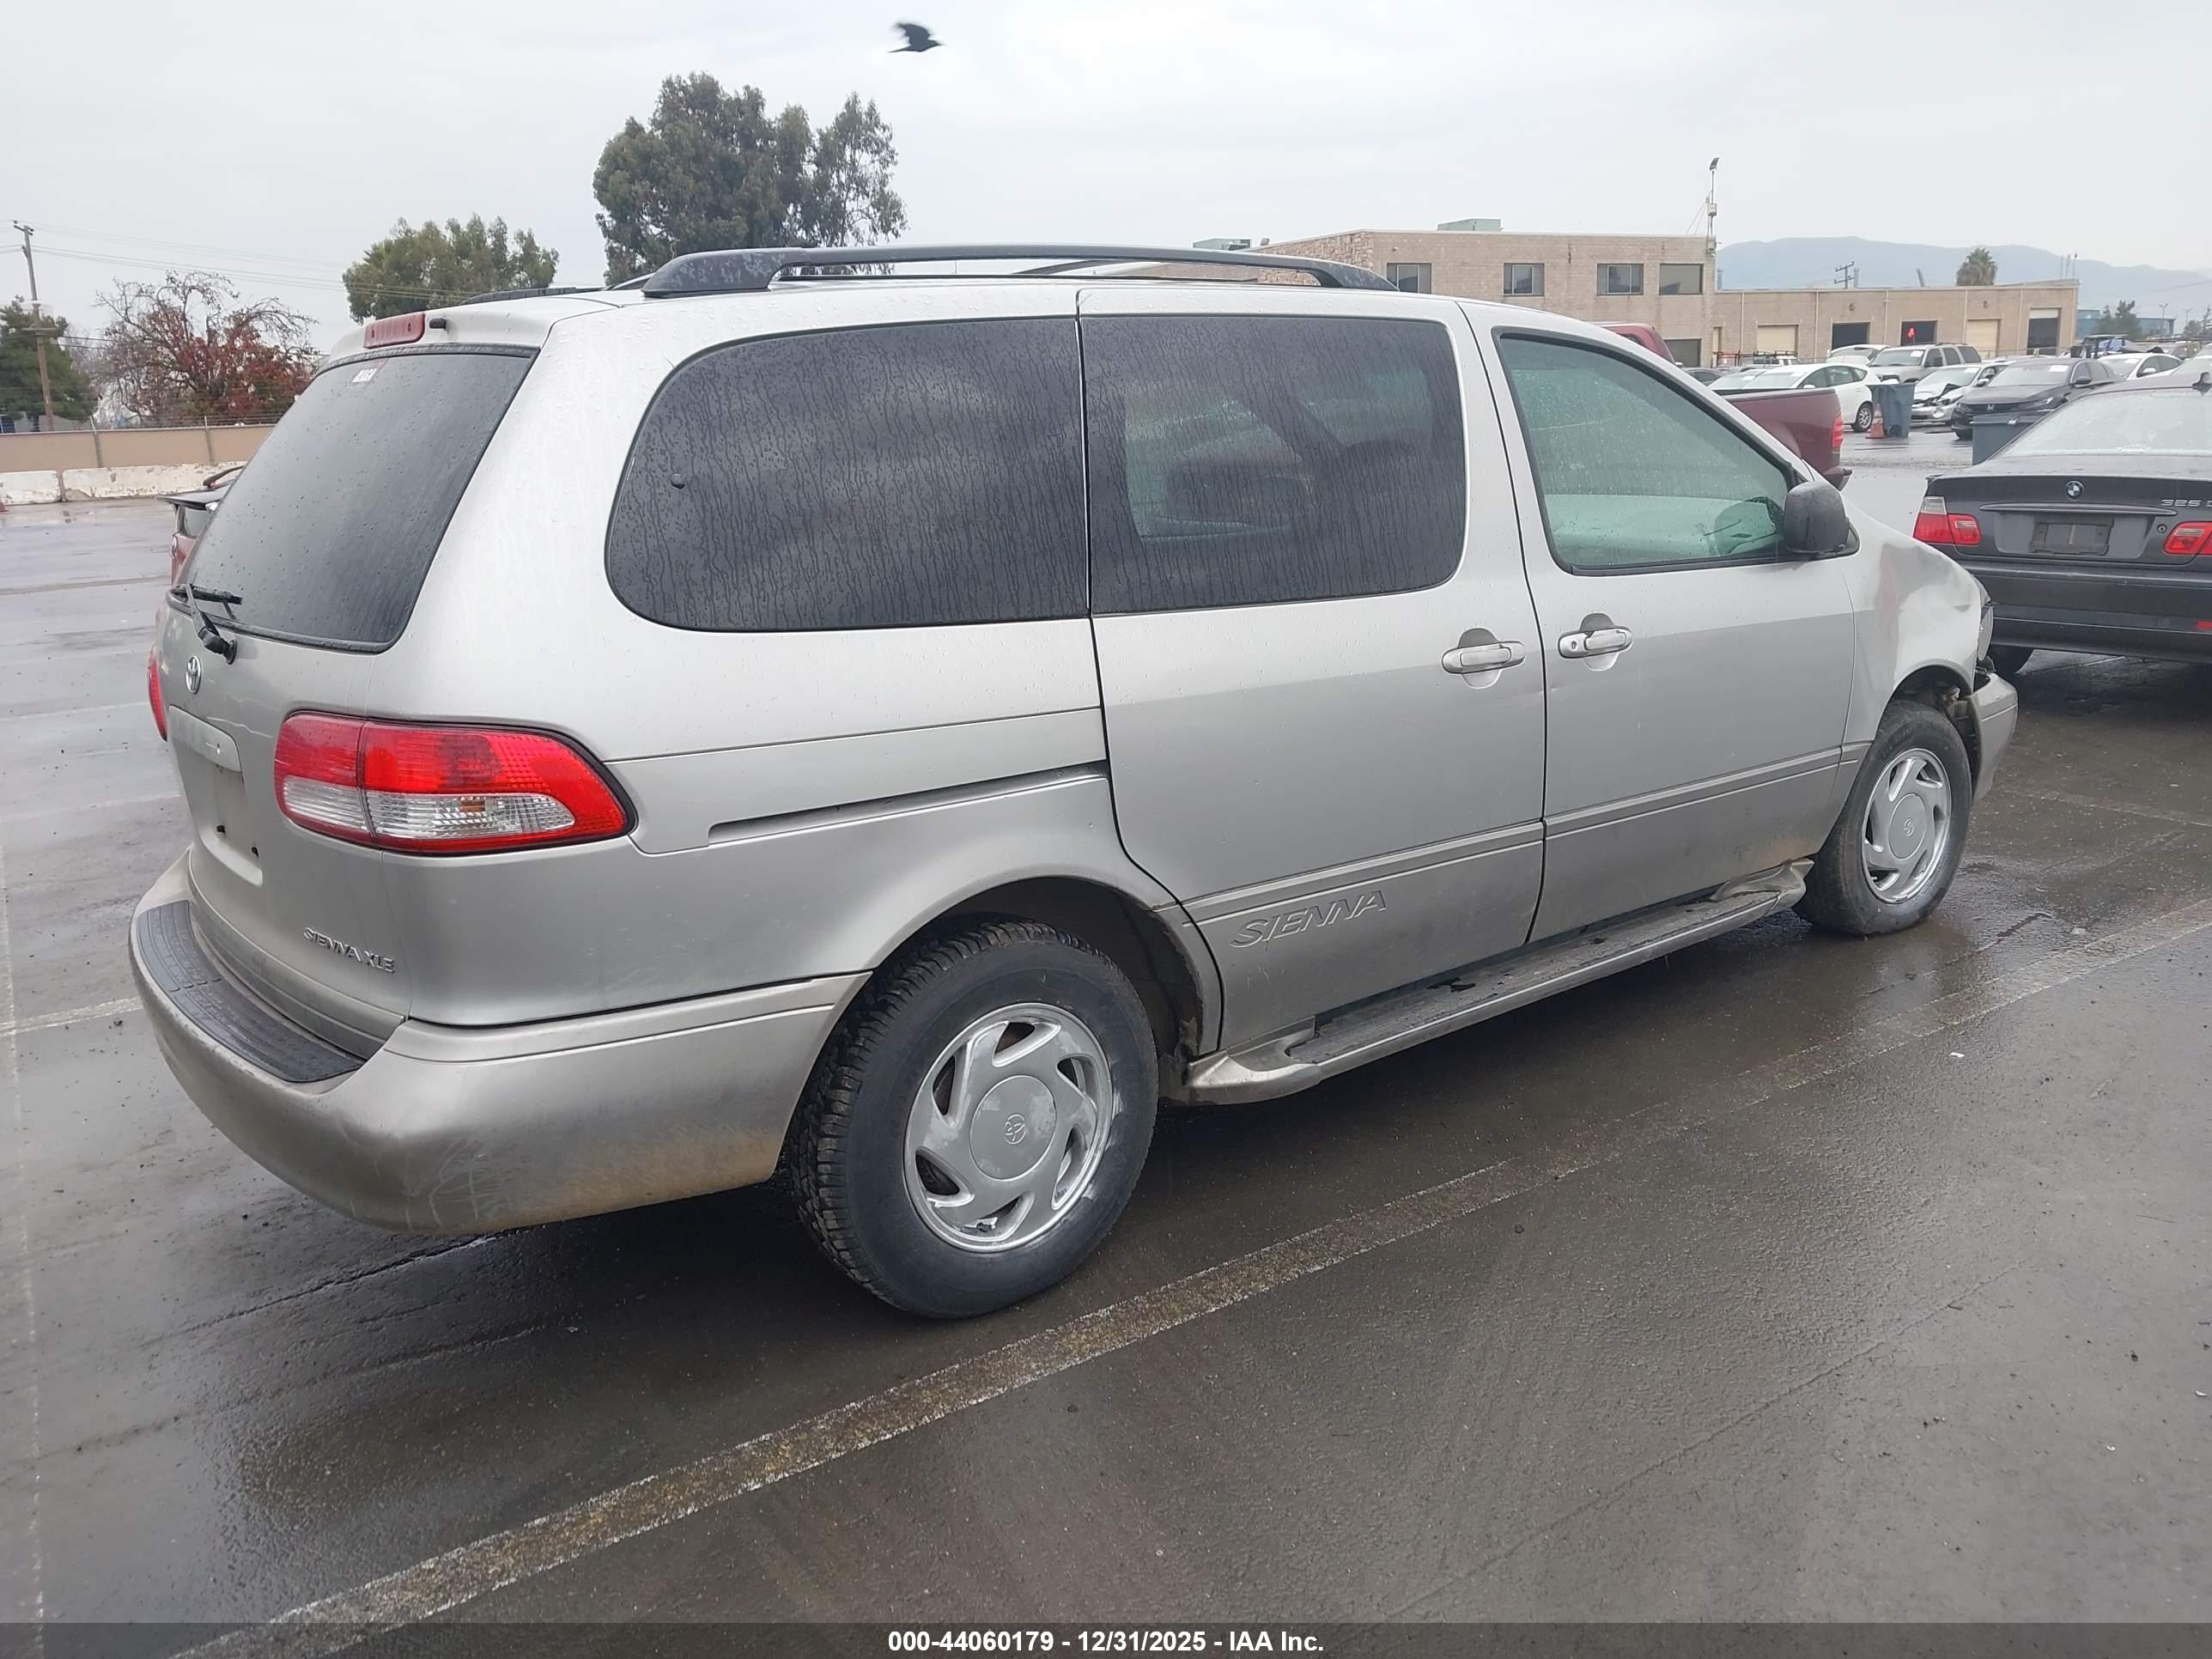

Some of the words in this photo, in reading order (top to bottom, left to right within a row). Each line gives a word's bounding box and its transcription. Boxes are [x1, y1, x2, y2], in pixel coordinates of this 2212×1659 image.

[1230, 890, 1388, 948] SIENNA
[302, 927, 362, 963] SIENNA
[364, 949, 395, 973] XLE
